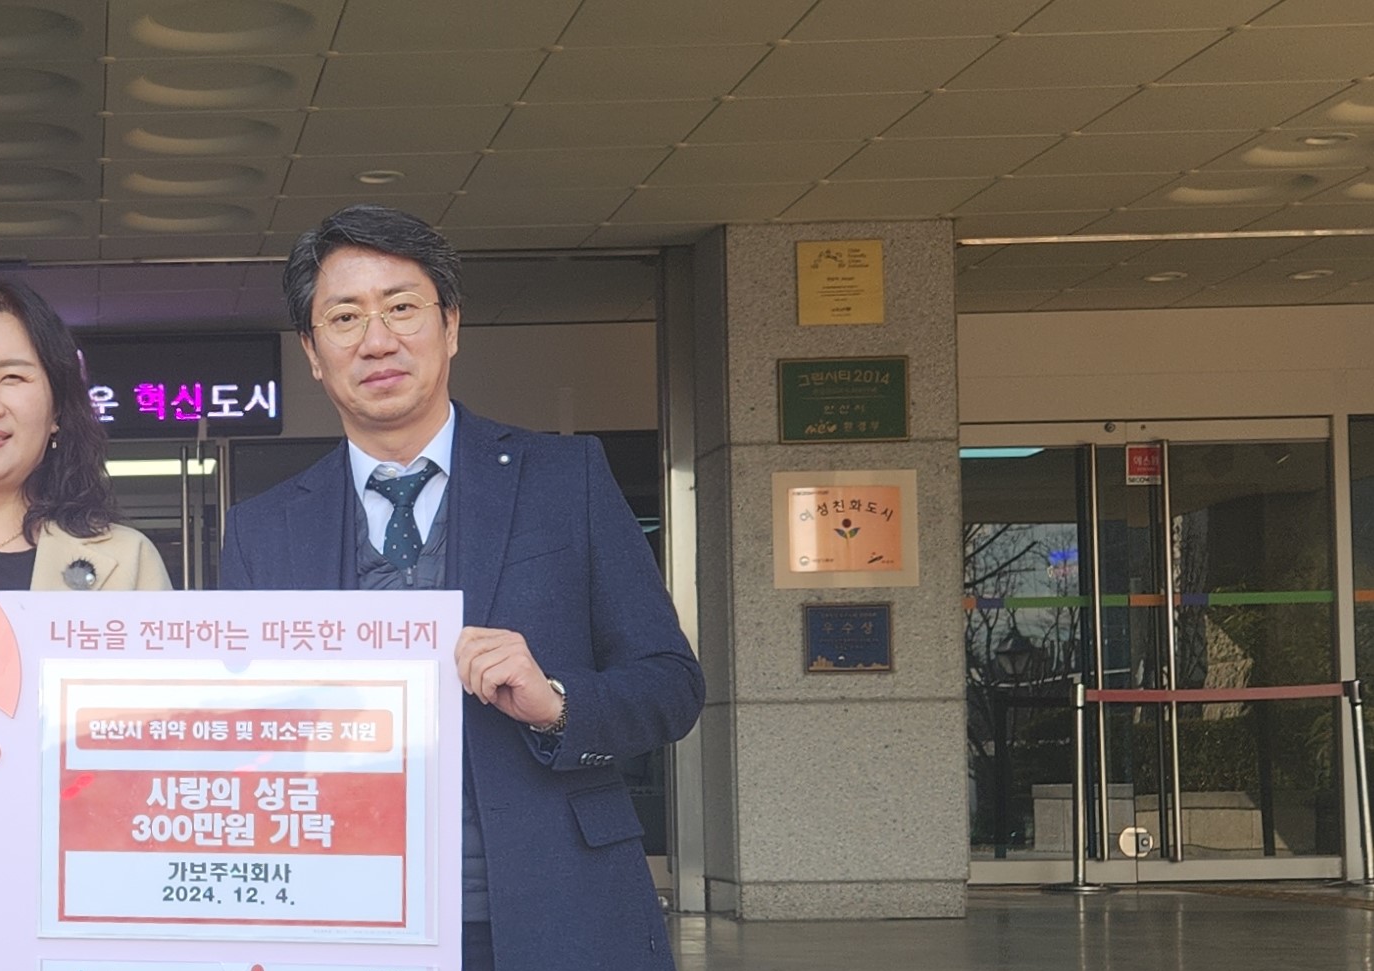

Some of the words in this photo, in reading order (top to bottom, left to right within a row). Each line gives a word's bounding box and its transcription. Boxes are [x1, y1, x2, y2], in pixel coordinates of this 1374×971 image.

[133, 380, 277, 421] 혁신도시
[799, 499, 894, 522] 여성친화도시
[49, 619, 129, 651] 나눔을
[139, 619, 250, 651] 전파하는
[262, 619, 346, 652] 따뜻한
[357, 619, 439, 651] 에너지
[89, 718, 143, 741] 안산시
[149, 719, 187, 741] 취약
[192, 719, 230, 742] 아동
[235, 720, 254, 742] 및
[260, 720, 334, 743] 저소득층
[340, 721, 377, 743] 지원
[146, 776, 241, 811] 사랑의
[253, 777, 320, 812] 성금
[131, 813, 255, 847] 300만원
[269, 813, 336, 849] 기탁
[167, 861, 293, 884] 가보주식회사
[161, 886, 223, 905] 2024.
[232, 887, 266, 906] 12.
[275, 888, 296, 906] 4.
